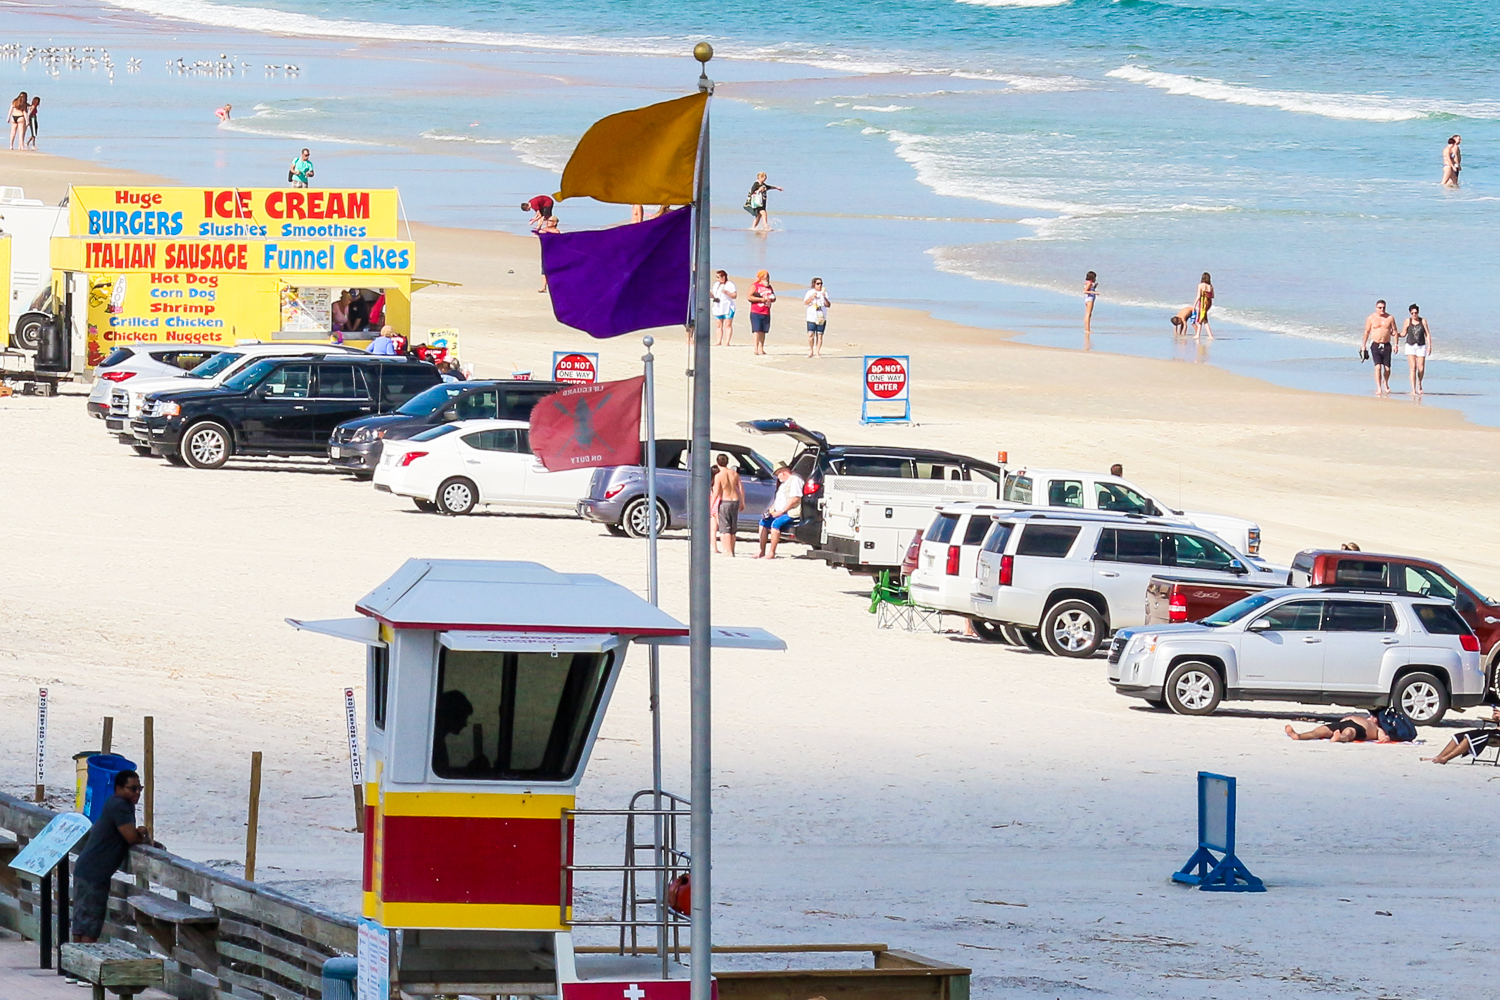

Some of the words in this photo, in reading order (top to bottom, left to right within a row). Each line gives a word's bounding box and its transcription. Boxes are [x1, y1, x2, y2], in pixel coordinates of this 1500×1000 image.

[115, 190, 162, 209] Huge
[204, 190, 252, 219] ICE
[265, 191, 370, 220] CREAM
[88, 210, 183, 235] BURGERS
[199, 222, 267, 236] Slushies
[282, 223, 366, 237] Smoothies
[85, 243, 156, 269] ITALIAN
[165, 243, 247, 270] SAUSAGE
[264, 244, 334, 270] Funnel
[344, 244, 409, 270] Cakes
[150, 273, 179, 284] Hot
[186, 273, 218, 288] Dog
[150, 288, 183, 298] Corn
[189, 288, 216, 301] Dog
[150, 303, 215, 315] Shrimp
[109, 317, 159, 327] Grilled
[165, 316, 223, 327] Chicken
[103, 331, 157, 341] Chicken
[166, 331, 222, 344] Nuggets
[560, 361, 572, 369] DO
[574, 361, 590, 369] NOT
[40, 698, 46, 706] NO
[347, 698, 353, 706] NO
